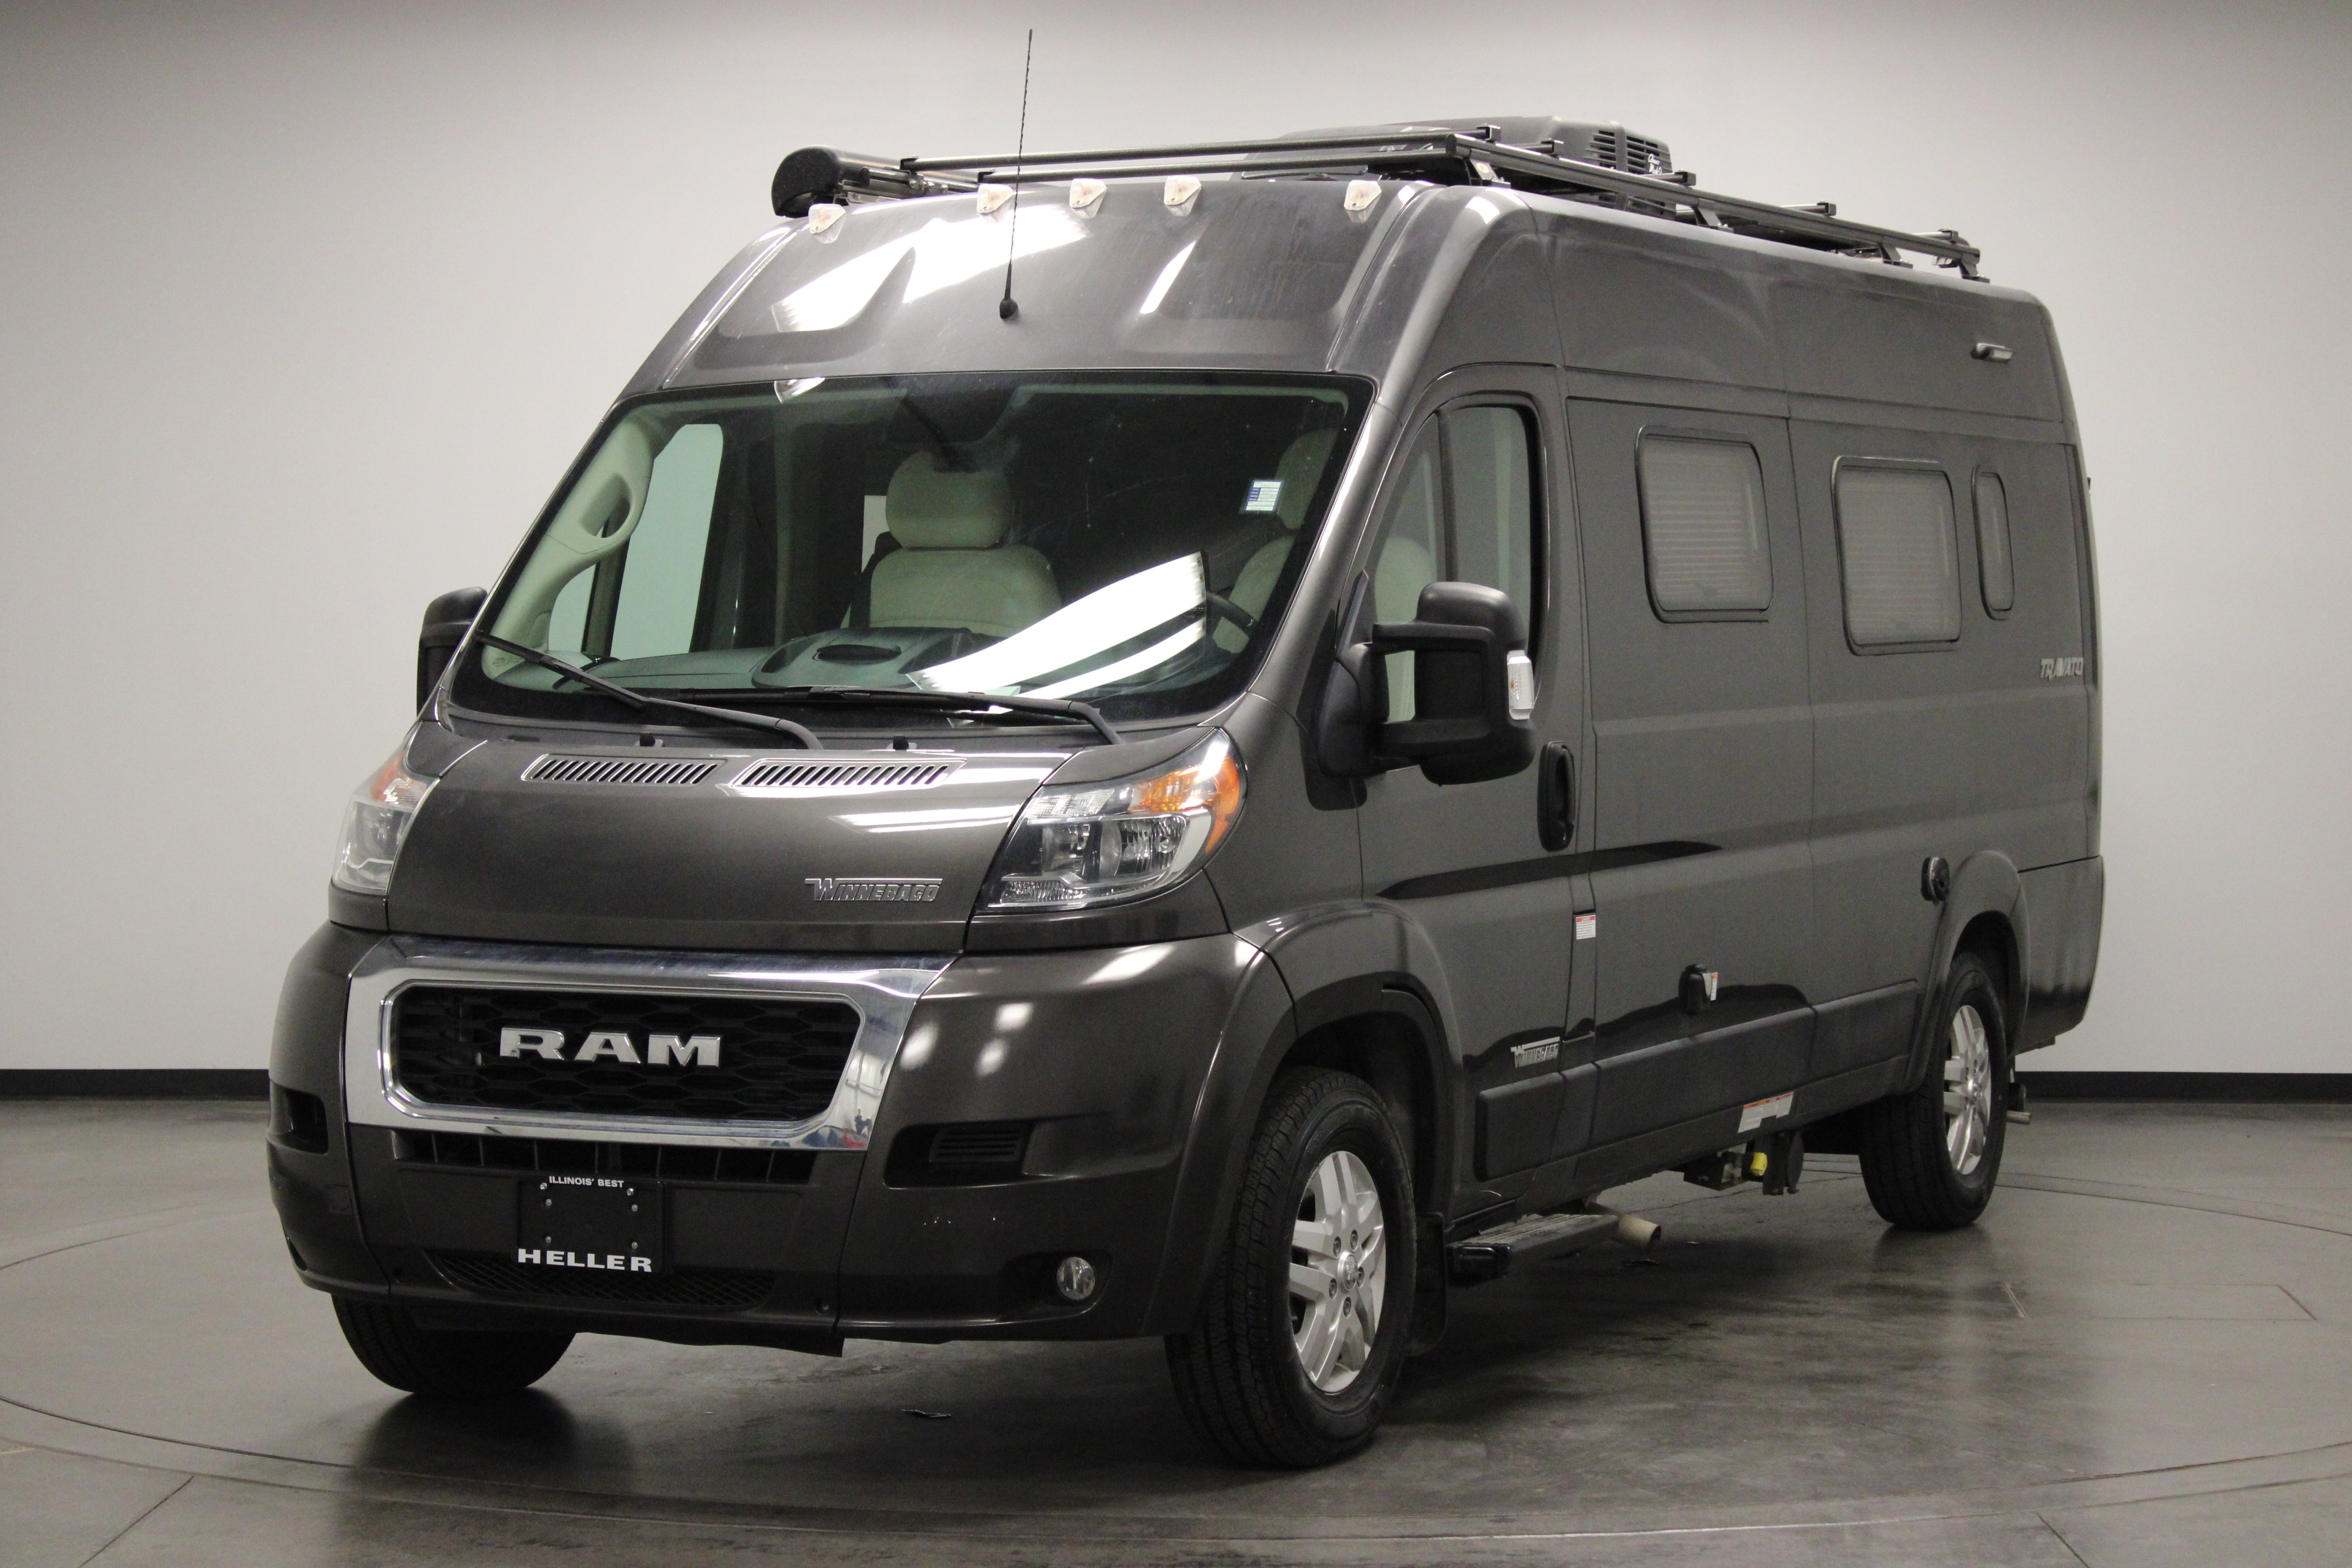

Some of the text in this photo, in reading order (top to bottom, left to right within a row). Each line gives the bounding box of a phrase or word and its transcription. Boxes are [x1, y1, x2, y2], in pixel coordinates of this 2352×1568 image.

[804, 878, 943, 901] WINNEBAGO
[499, 1027, 721, 1067] RAM
[549, 1176, 624, 1188] ILLINOIS' BEST
[518, 1248, 652, 1272] HELLER
